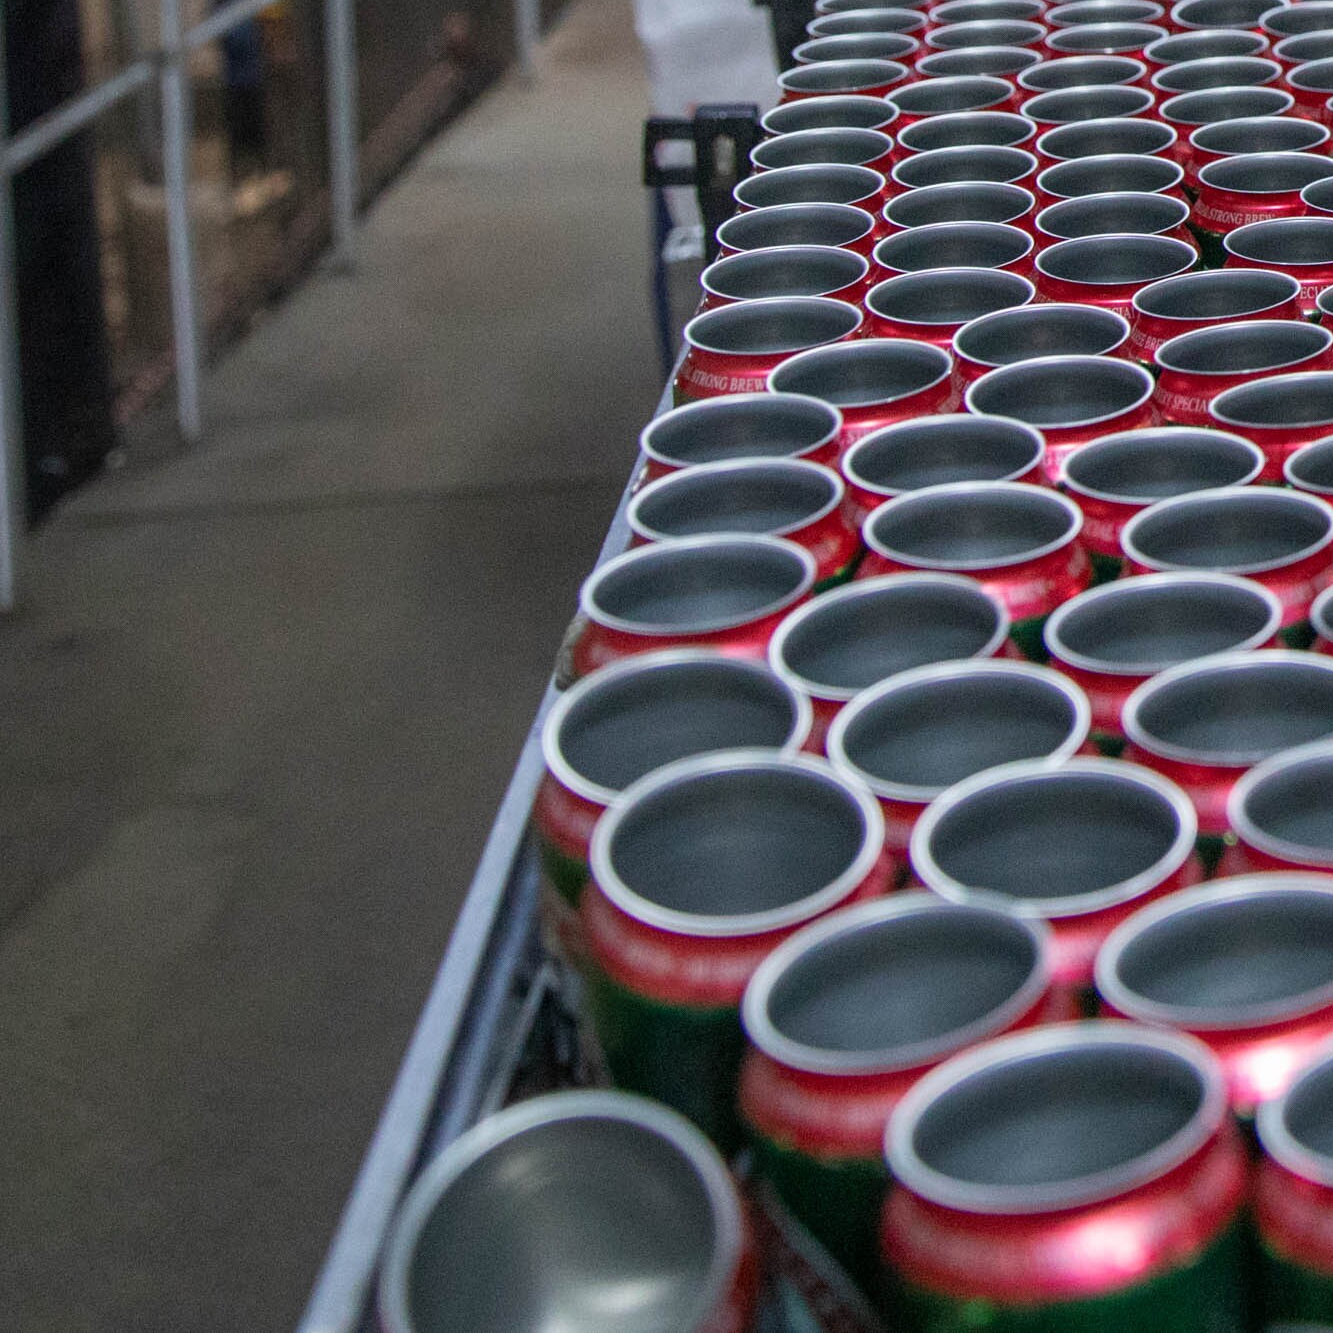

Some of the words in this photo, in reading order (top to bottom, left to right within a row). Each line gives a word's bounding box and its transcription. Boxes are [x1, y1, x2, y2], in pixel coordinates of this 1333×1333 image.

[1210, 208, 1243, 225] STRONG
[690, 368, 728, 391] STRONG
[729, 377, 767, 392] BREW
[1172, 395, 1209, 412] SPECIA
